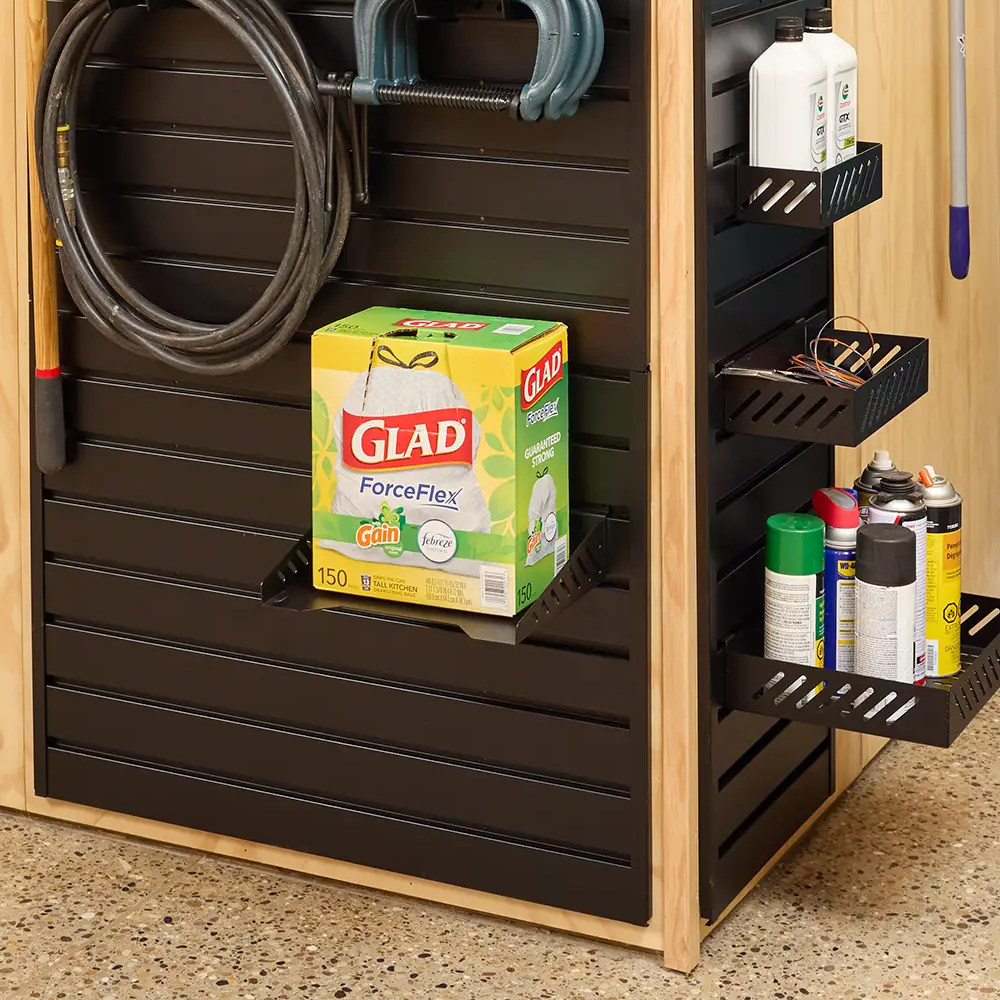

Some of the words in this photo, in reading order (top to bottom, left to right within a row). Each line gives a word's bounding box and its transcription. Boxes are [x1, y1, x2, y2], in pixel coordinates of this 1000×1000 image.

[839, 112, 851, 123] GTX
[402, 319, 482, 330] GLAD
[524, 350, 561, 403] GLAD
[526, 397, 559, 427] ForceFlex
[351, 419, 466, 464] GLAD
[524, 431, 561, 459] GUARANTEED
[532, 447, 555, 468] STRONG
[360, 476, 463, 506] ForceFlex
[356, 523, 400, 548] Gain
[421, 532, 453, 548] febreze
[839, 562, 855, 570] WD-4
[317, 567, 348, 588] 150
[373, 580, 388, 589] TALL
[389, 582, 418, 593] KITCHEN
[517, 582, 532, 606] 150
